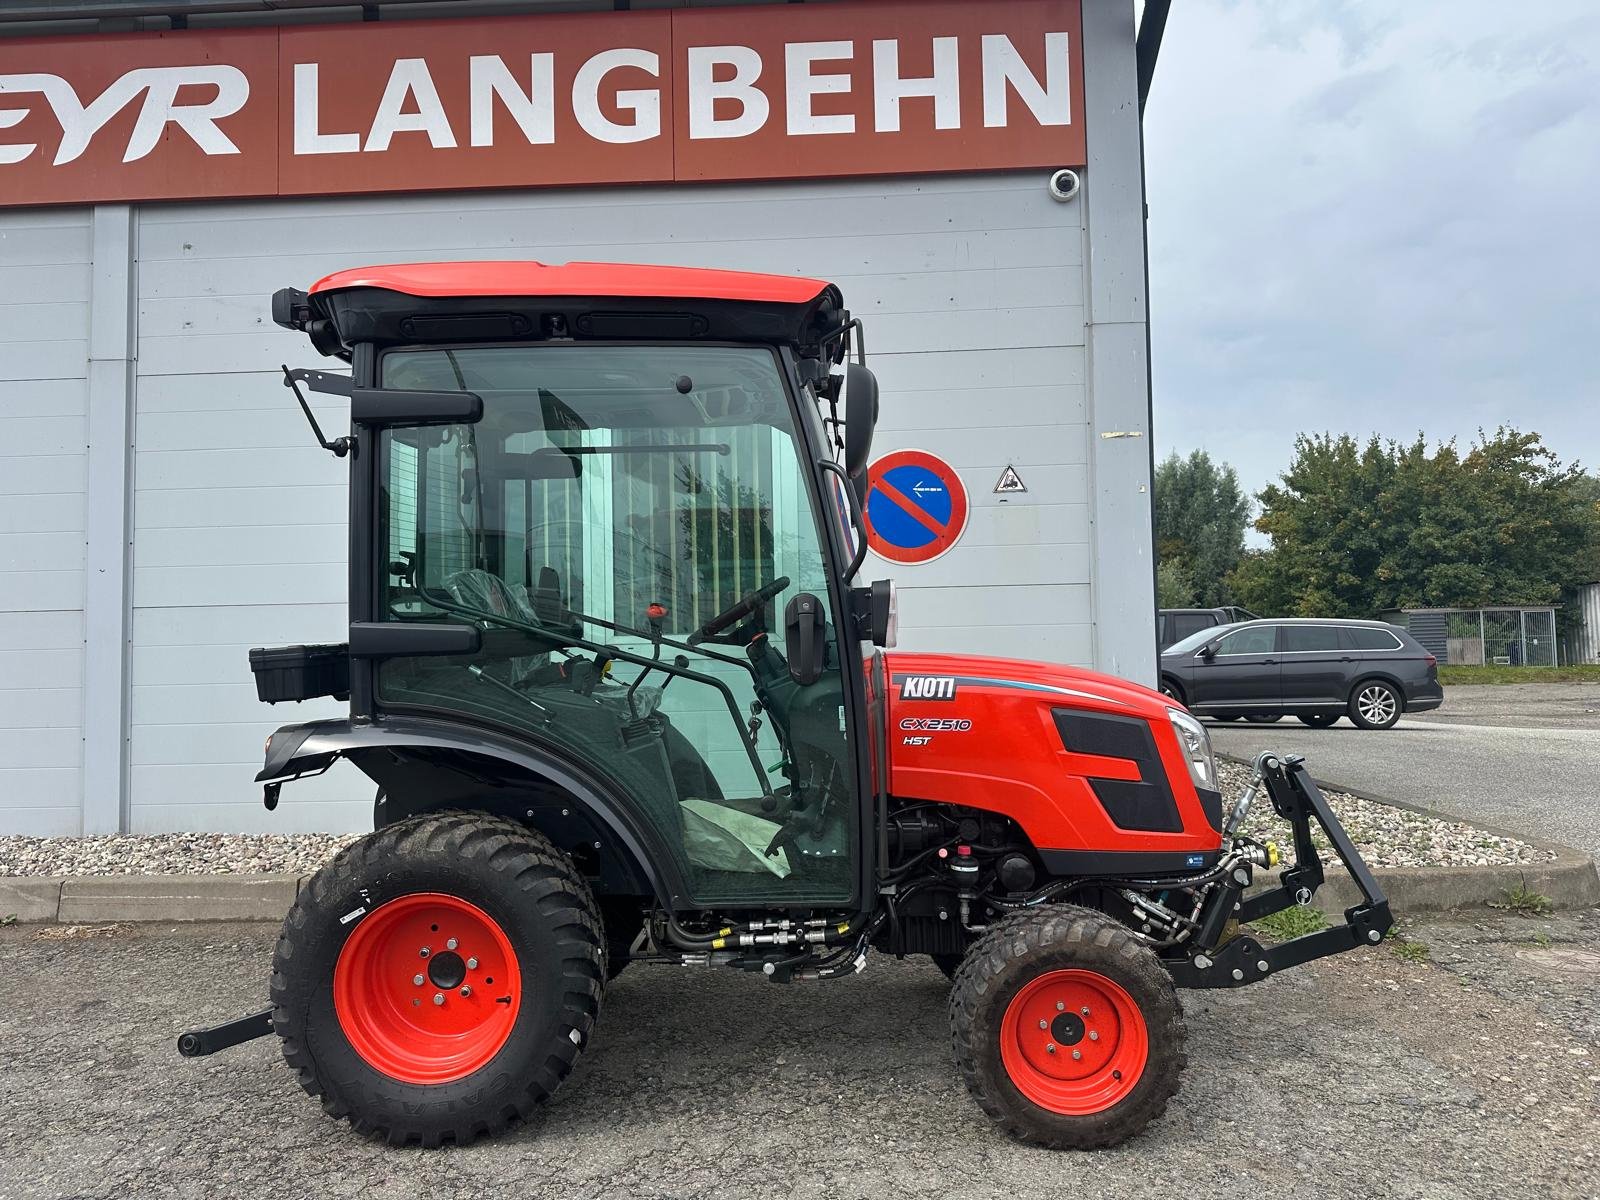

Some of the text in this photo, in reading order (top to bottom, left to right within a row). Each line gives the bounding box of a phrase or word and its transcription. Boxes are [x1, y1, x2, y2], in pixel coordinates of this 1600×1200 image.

[293, 32, 1072, 155] LANGBEHN
[903, 677, 955, 698] KIOTI
[900, 718, 972, 732] CX2510
[903, 736, 932, 746] HST
